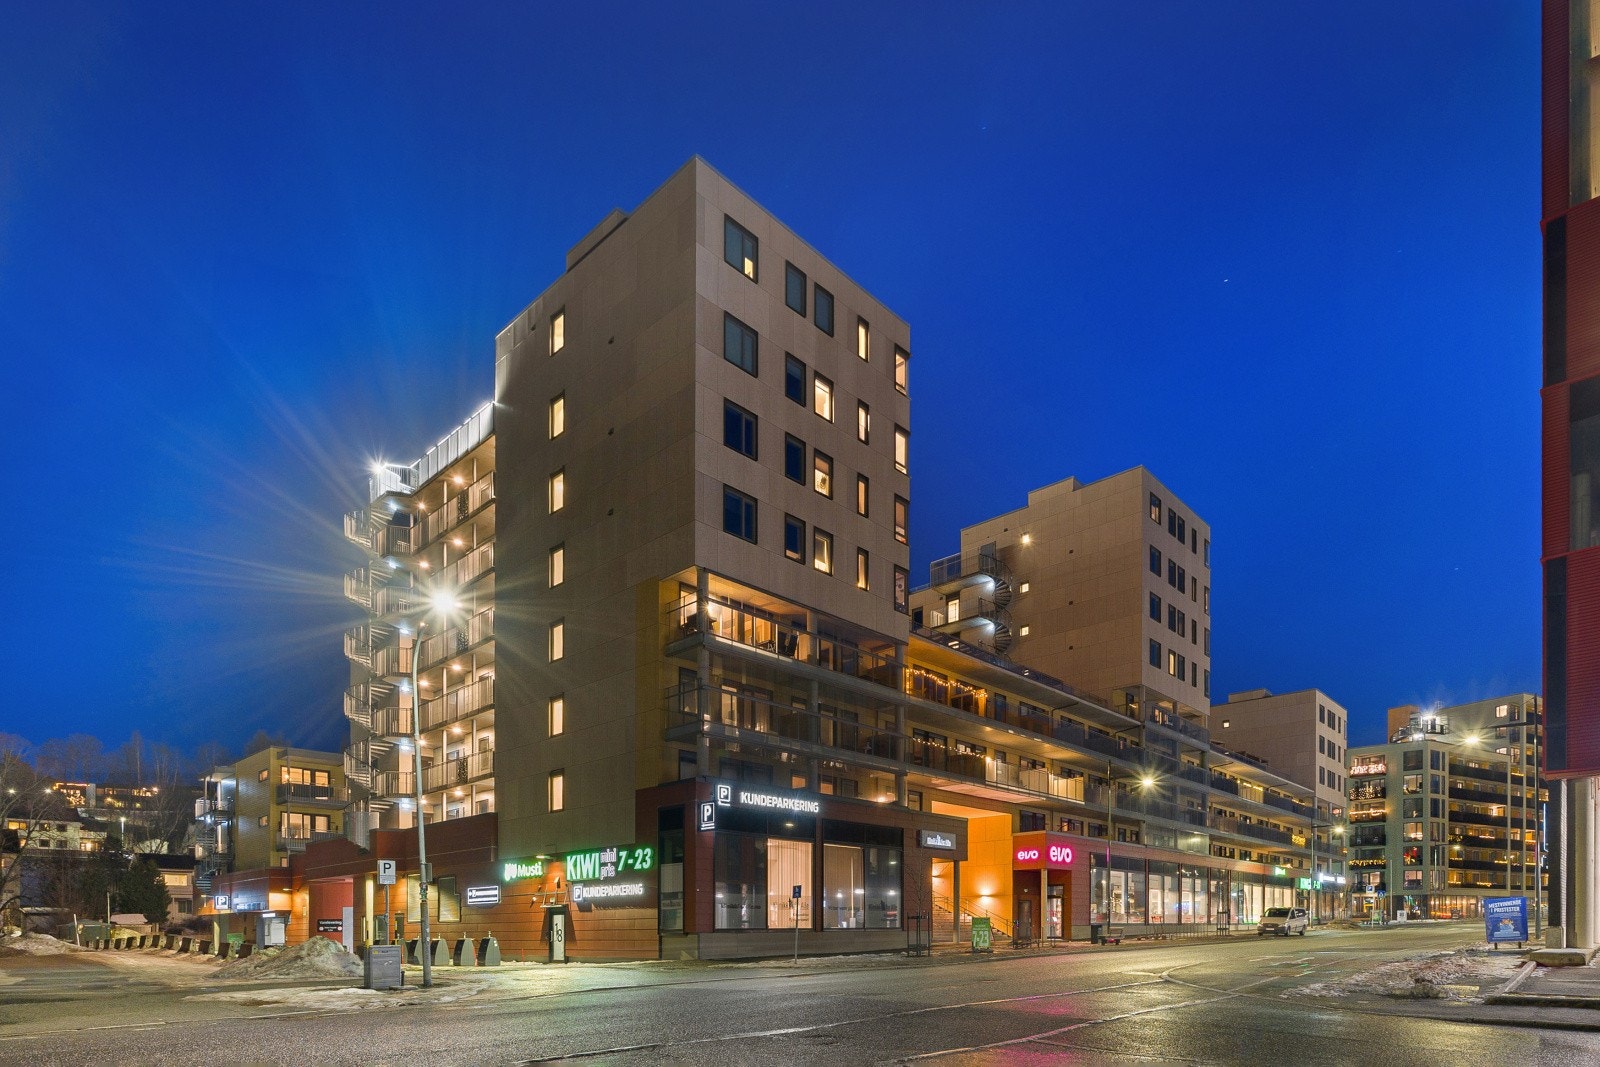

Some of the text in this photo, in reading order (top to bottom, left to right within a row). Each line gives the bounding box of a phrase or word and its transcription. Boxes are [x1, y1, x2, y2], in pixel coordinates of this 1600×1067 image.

[720, 788, 819, 813] P KUNDEPARKERING
[704, 805, 712, 822] P
[1017, 850, 1039, 860] evo
[1049, 846, 1072, 863] evo
[383, 862, 392, 874] P
[517, 861, 543, 878] Musti
[566, 847, 617, 880] KIWI mini
[600, 863, 615, 881] pris
[583, 883, 643, 898] KUNDEPARKERING
[217, 896, 226, 907] P
[972, 930, 989, 947] 7-23
